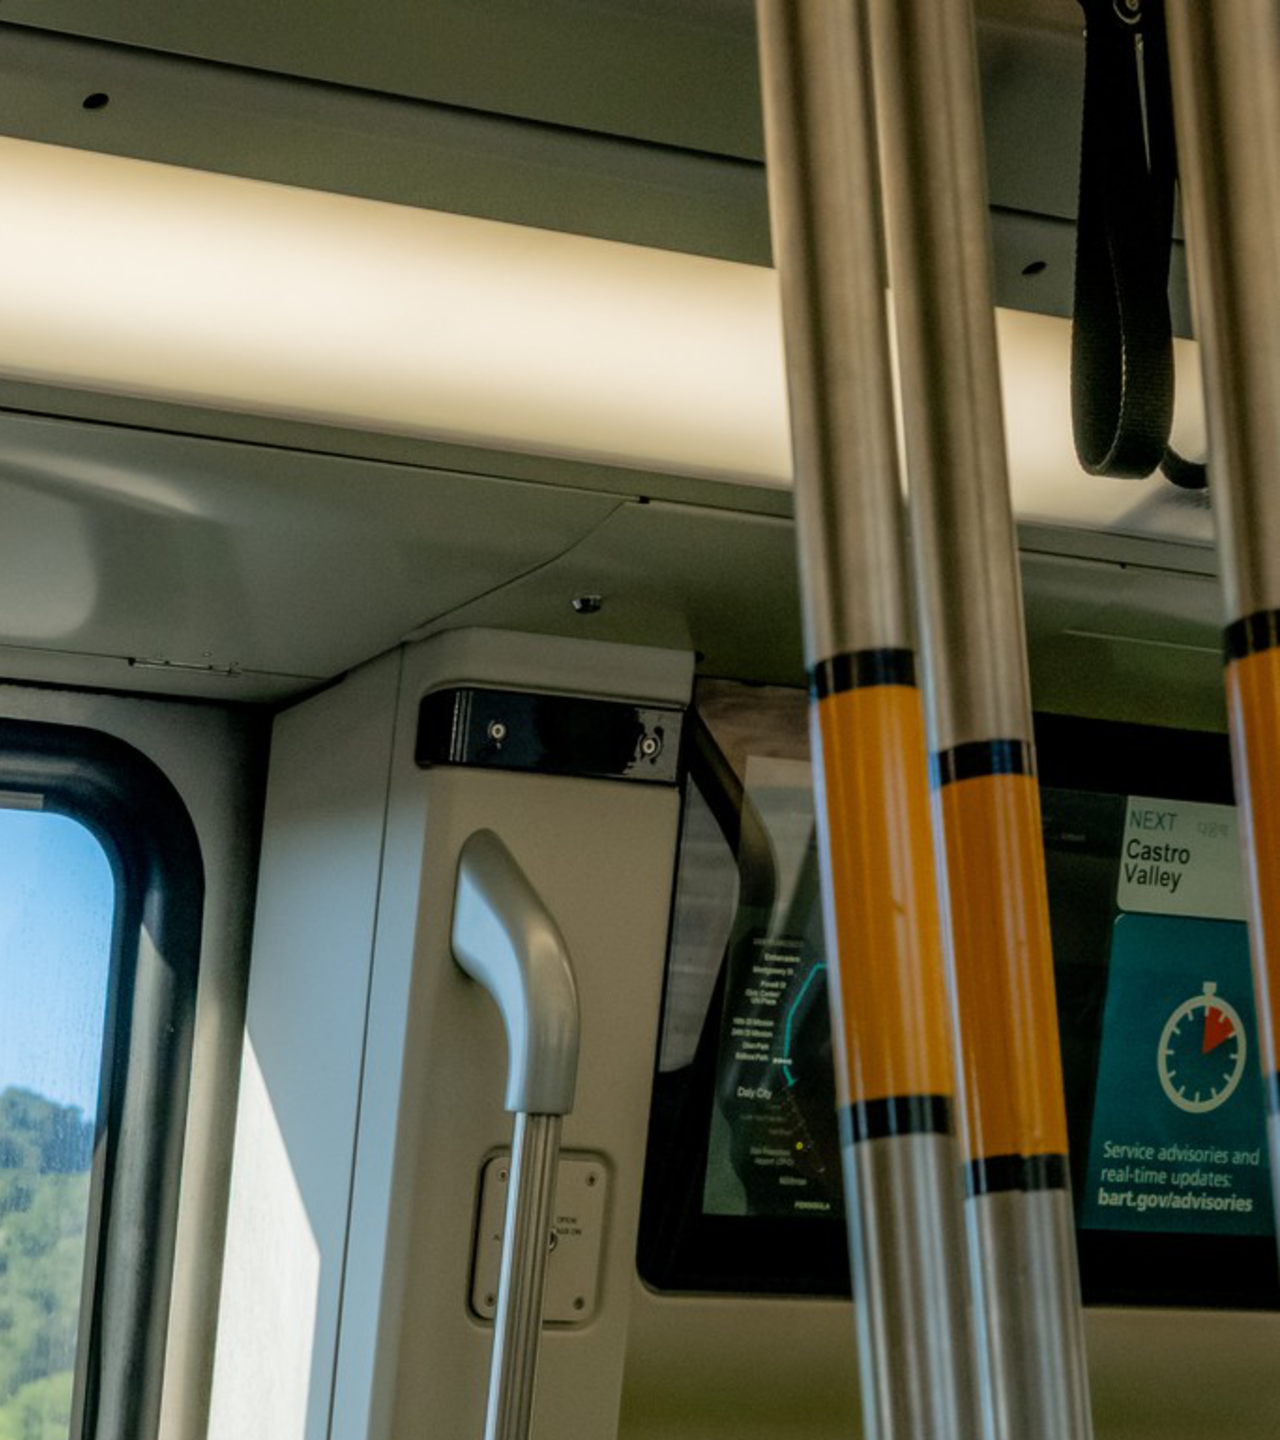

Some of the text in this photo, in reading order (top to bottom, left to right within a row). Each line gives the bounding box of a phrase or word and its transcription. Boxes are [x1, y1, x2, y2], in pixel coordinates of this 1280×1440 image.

[1130, 809, 1178, 831] NEXT
[1126, 838, 1190, 864] Castro
[1124, 863, 1182, 893] Valley
[736, 1086, 773, 1101] Daly City
[1103, 1140, 1260, 1166] Service advisories and
[1100, 1165, 1233, 1189] real-time updates:
[1097, 1187, 1253, 1212] bart.gov/advisories
